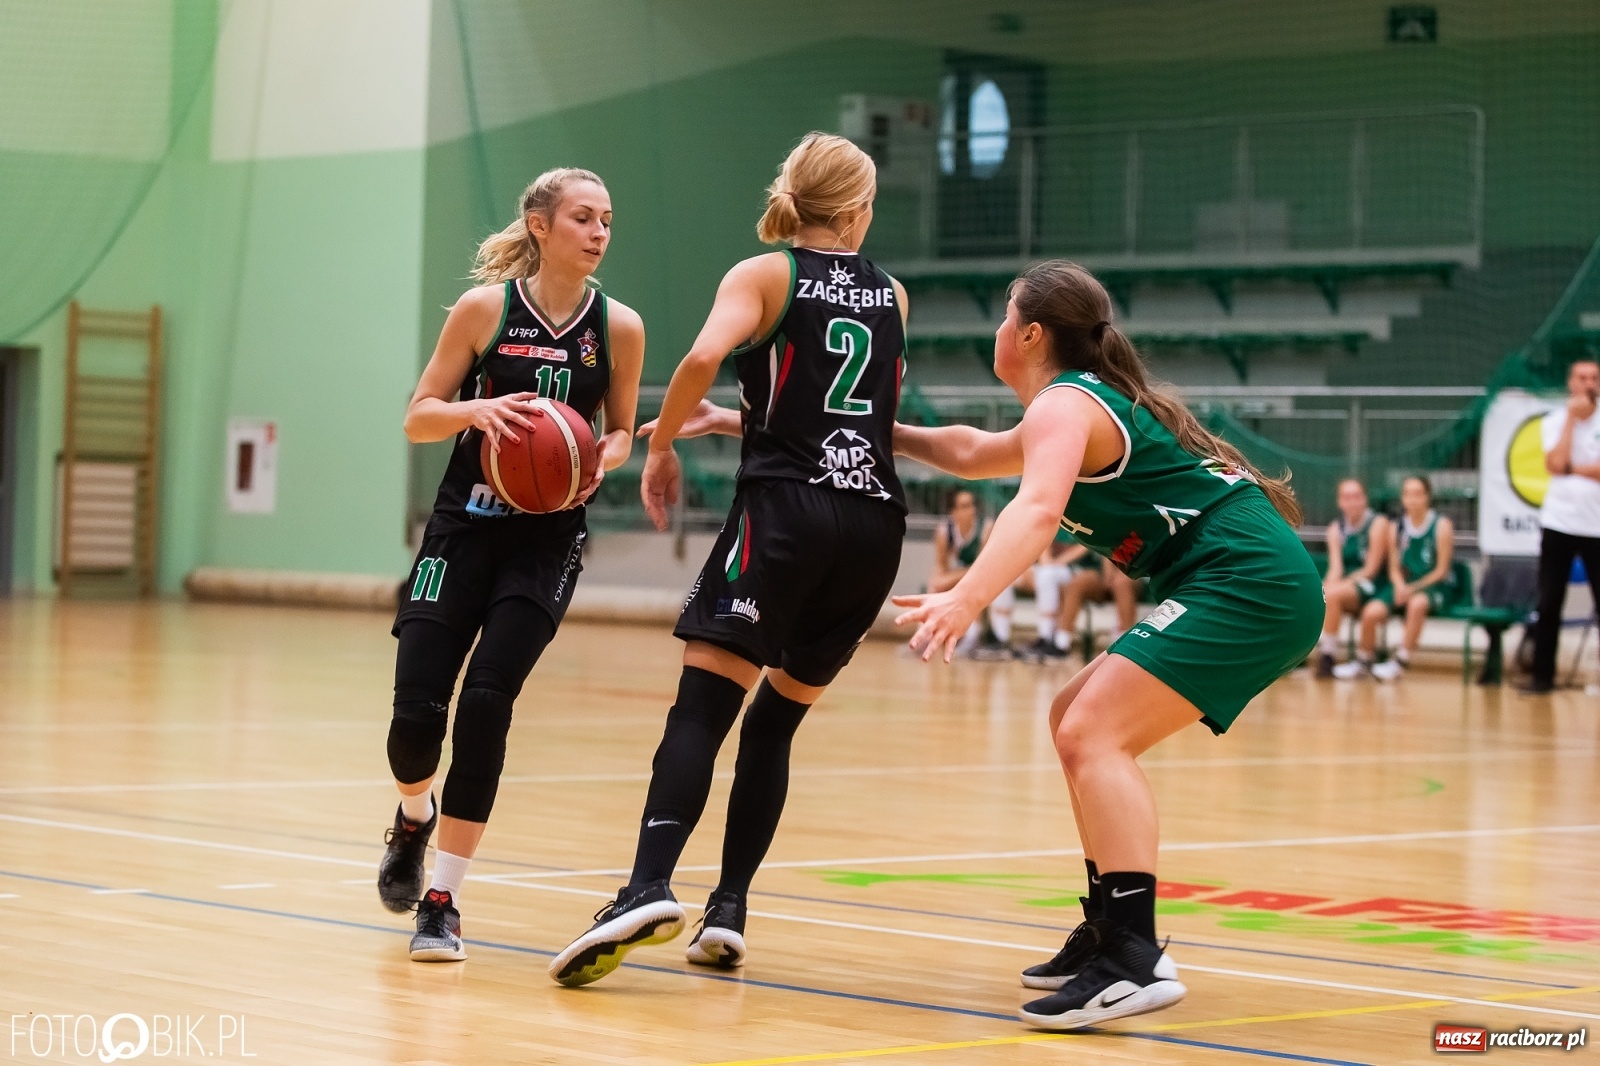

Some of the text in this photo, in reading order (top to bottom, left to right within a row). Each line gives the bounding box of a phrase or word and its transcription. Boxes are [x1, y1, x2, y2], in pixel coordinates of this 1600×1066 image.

[796, 278, 893, 313] ZAGŁĘBIE
[535, 365, 571, 404] 11
[823, 317, 873, 416] 2
[825, 446, 866, 470] MP
[832, 469, 872, 490] GO!
[410, 556, 448, 602] 11
